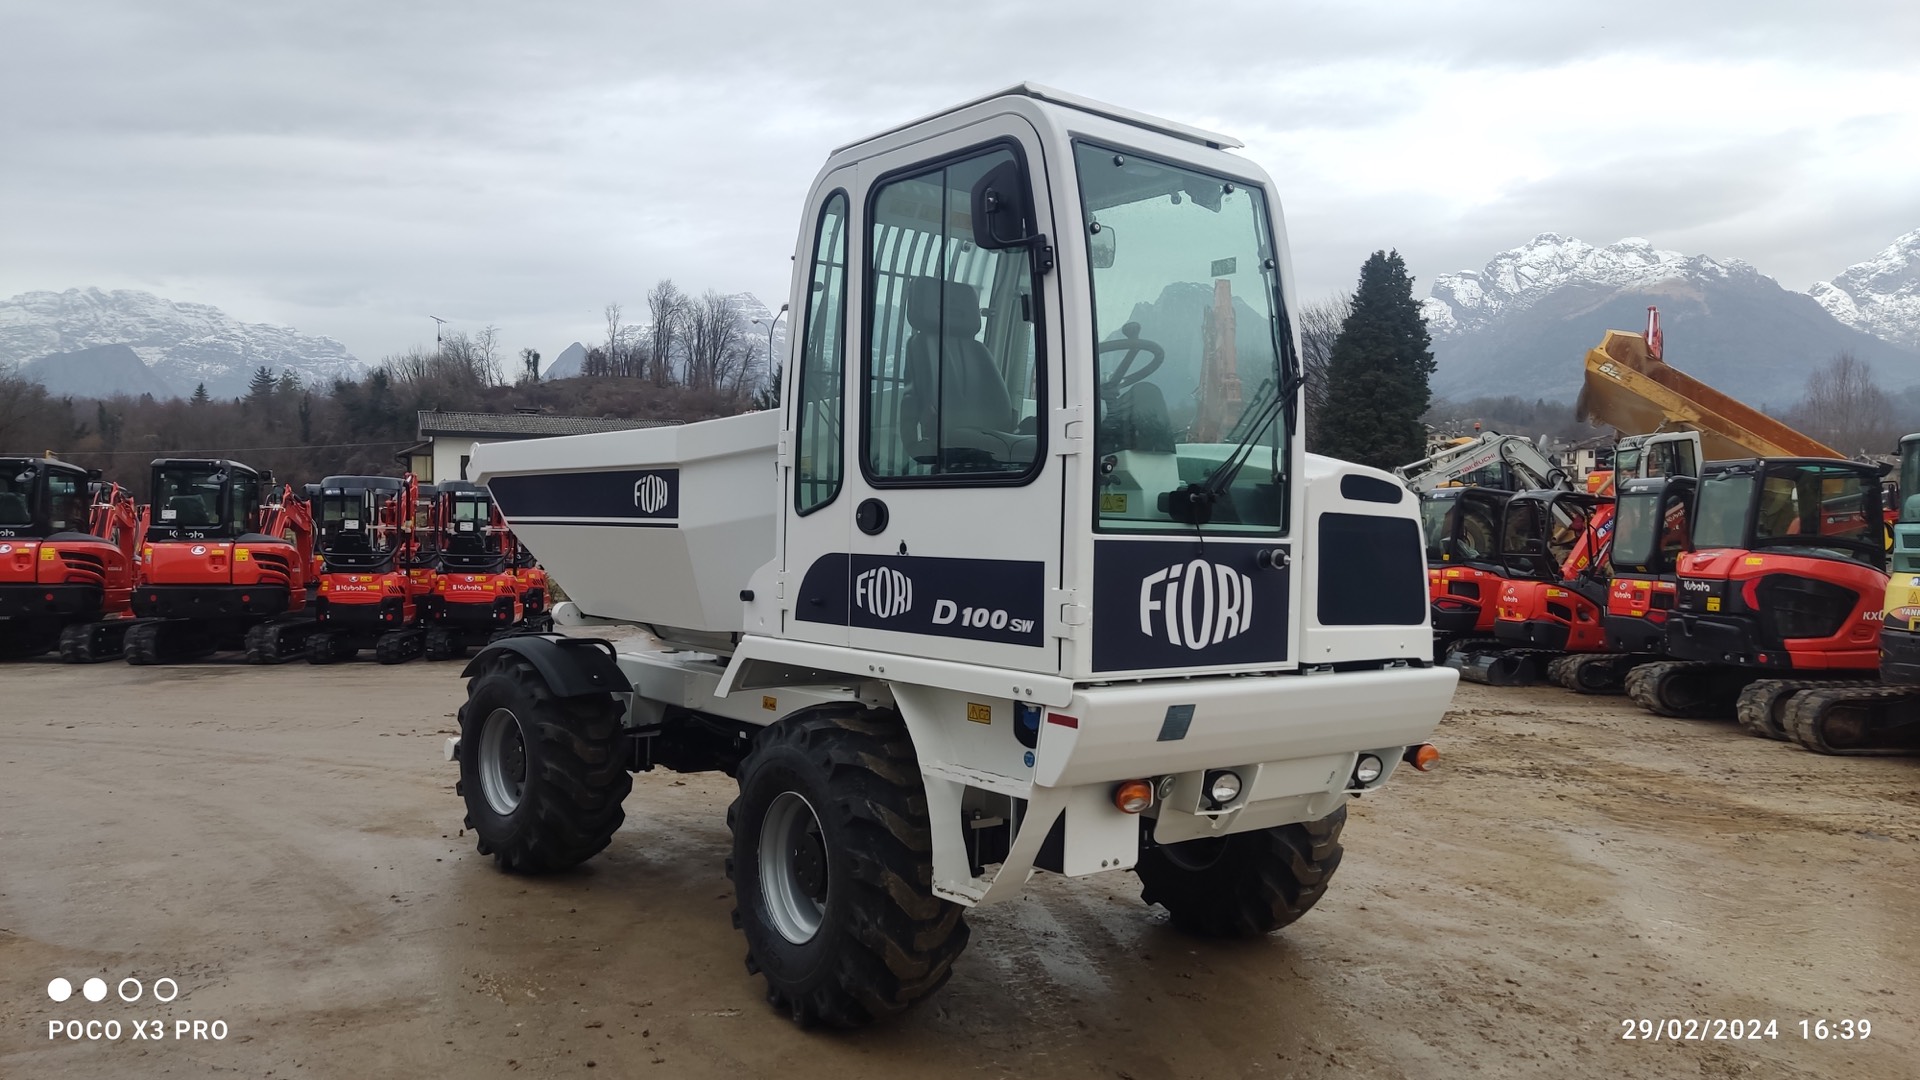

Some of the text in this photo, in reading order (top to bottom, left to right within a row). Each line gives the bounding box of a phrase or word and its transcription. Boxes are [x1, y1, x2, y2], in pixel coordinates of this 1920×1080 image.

[1460, 453, 1496, 474] TAKEUCHI
[169, 530, 204, 538] Kota
[1684, 581, 1710, 592] Kubota
[1503, 595, 1518, 603] Kubota
[1614, 591, 1632, 599] Kubota
